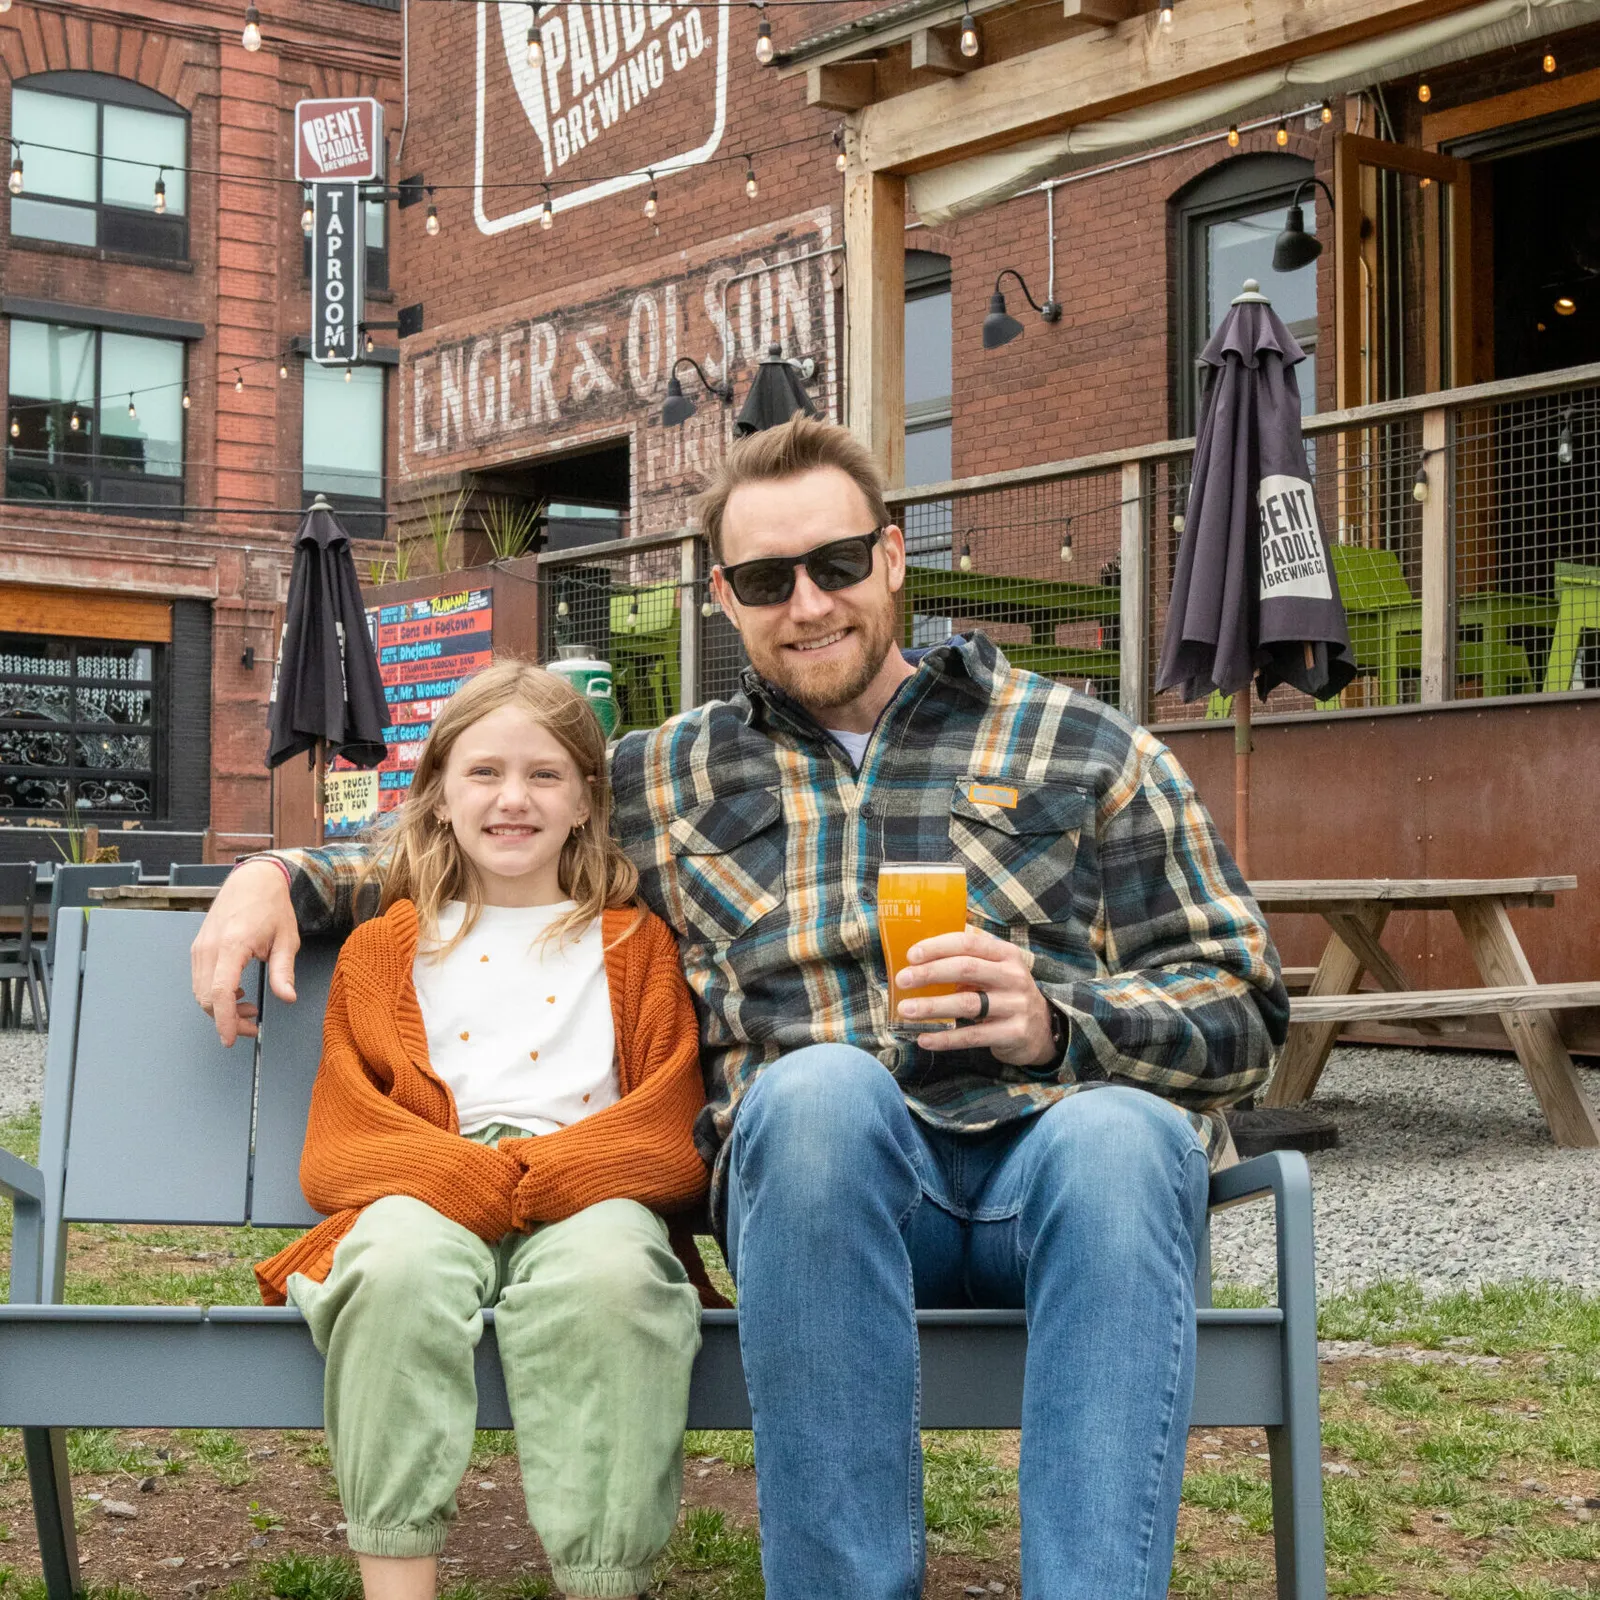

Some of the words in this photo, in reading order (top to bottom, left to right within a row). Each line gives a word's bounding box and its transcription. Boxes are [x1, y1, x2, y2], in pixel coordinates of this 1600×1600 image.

[552, 39, 665, 167] BREWING
[313, 107, 362, 145] BENT
[318, 133, 366, 163] PADDLE
[324, 153, 358, 172] BREWING
[324, 191, 346, 347] TAPROOM
[413, 320, 561, 454] ENGER
[628, 242, 812, 398] OLSON
[1260, 488, 1312, 546] BENT
[1262, 530, 1321, 572] PADDLE
[1266, 560, 1314, 590] BREWING
[400, 624, 420, 640] Sons
[435, 616, 475, 635] Fogtown
[400, 685, 414, 700] Mr.
[325, 781, 339, 792] OOD
[343, 776, 372, 789] TRUCKS
[344, 788, 369, 800] MUSIC
[352, 799, 367, 811] FUN
